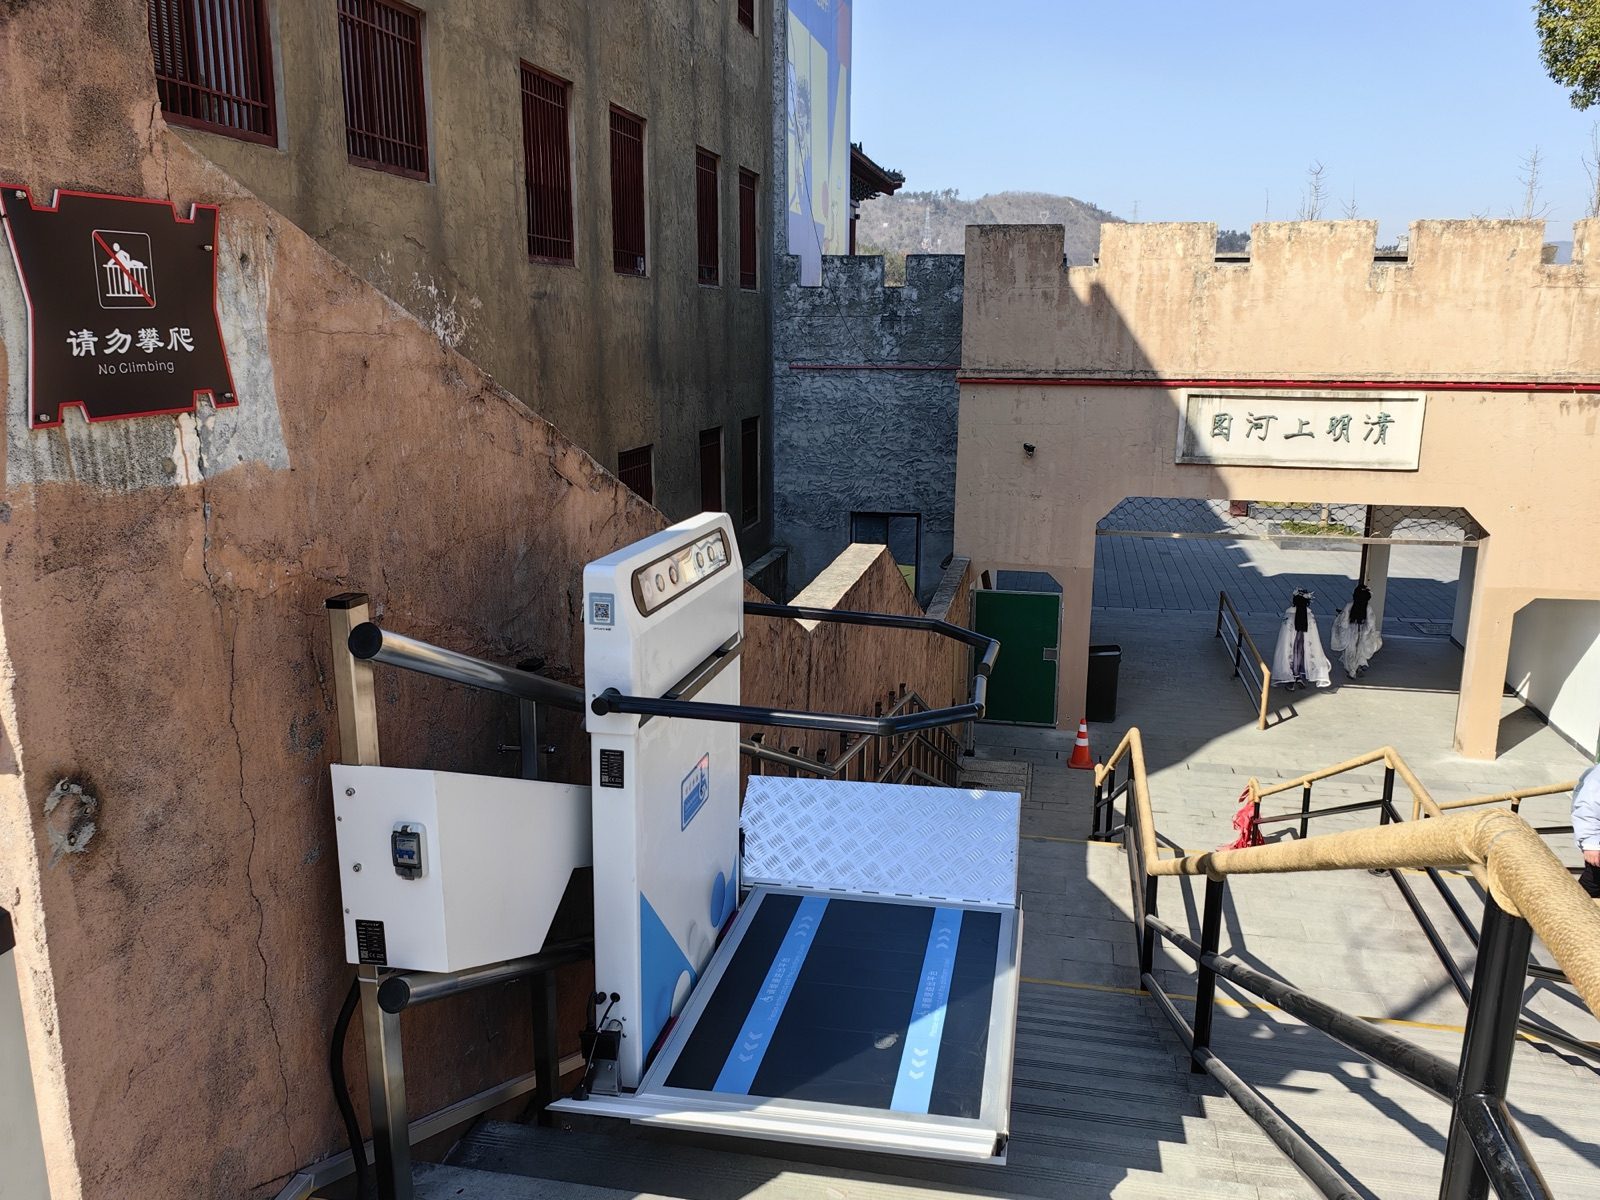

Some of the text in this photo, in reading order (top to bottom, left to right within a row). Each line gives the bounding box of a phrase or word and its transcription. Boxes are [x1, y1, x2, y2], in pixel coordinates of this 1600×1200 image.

[66, 327, 195, 357] 请勿攀爬
[98, 360, 175, 375] No Climbing
